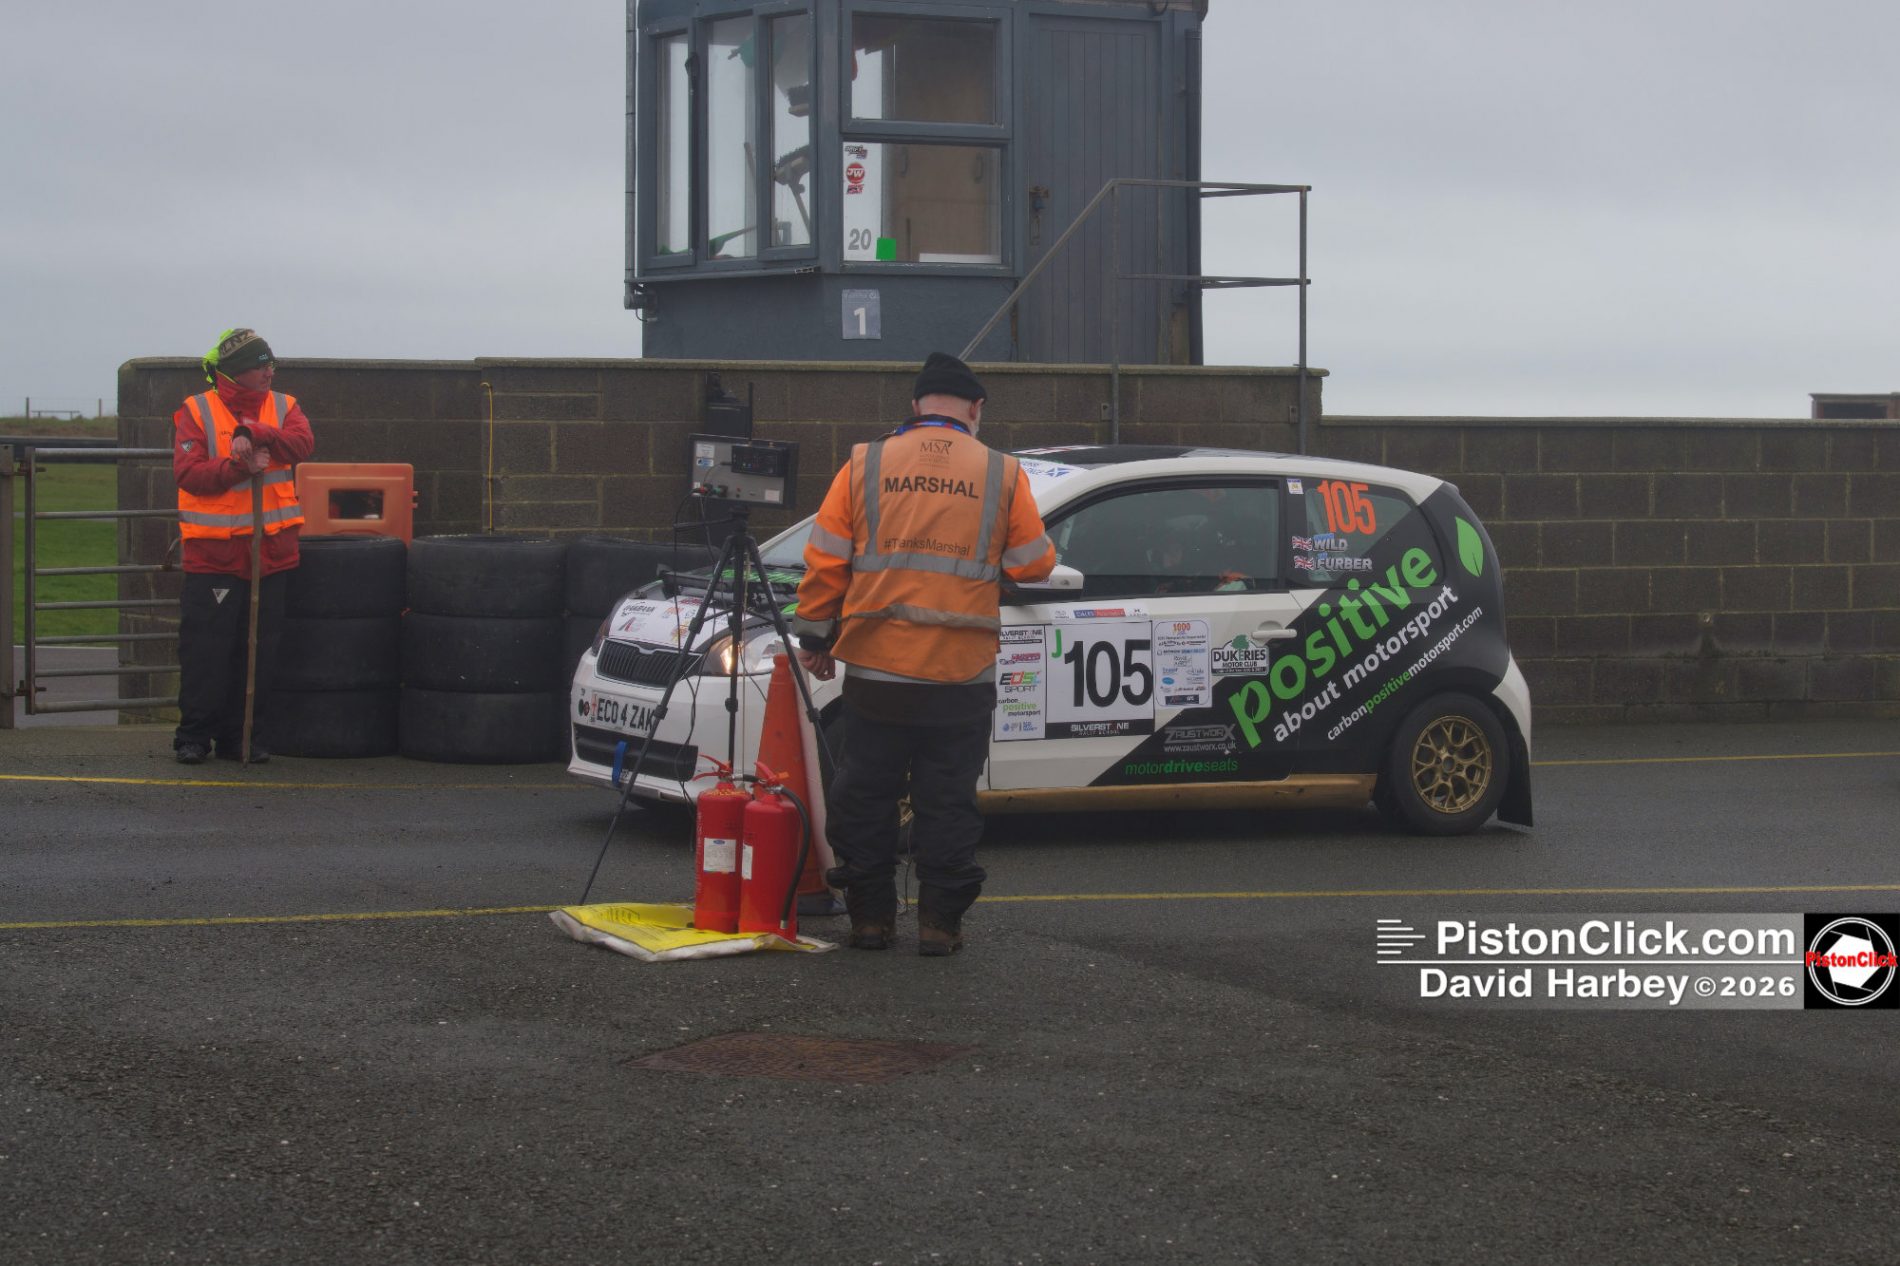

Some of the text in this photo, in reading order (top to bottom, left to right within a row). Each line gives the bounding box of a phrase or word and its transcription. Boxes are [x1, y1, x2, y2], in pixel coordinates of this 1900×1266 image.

[849, 229, 872, 250] 20
[853, 307, 867, 336] 1
[919, 441, 951, 455] MSA
[884, 475, 979, 499] MARSHAL
[1316, 479, 1377, 535] 105
[1313, 538, 1348, 551] WILD
[1316, 557, 1373, 571] FURBER
[1213, 649, 1266, 662] DUKERIES
[1228, 547, 1438, 749] positive
[1064, 639, 1154, 708] 105
[1273, 584, 1459, 742] about motorsport
[1327, 605, 1483, 741] carbonpositivemotorsport.com
[1003, 702, 1037, 713] positive
